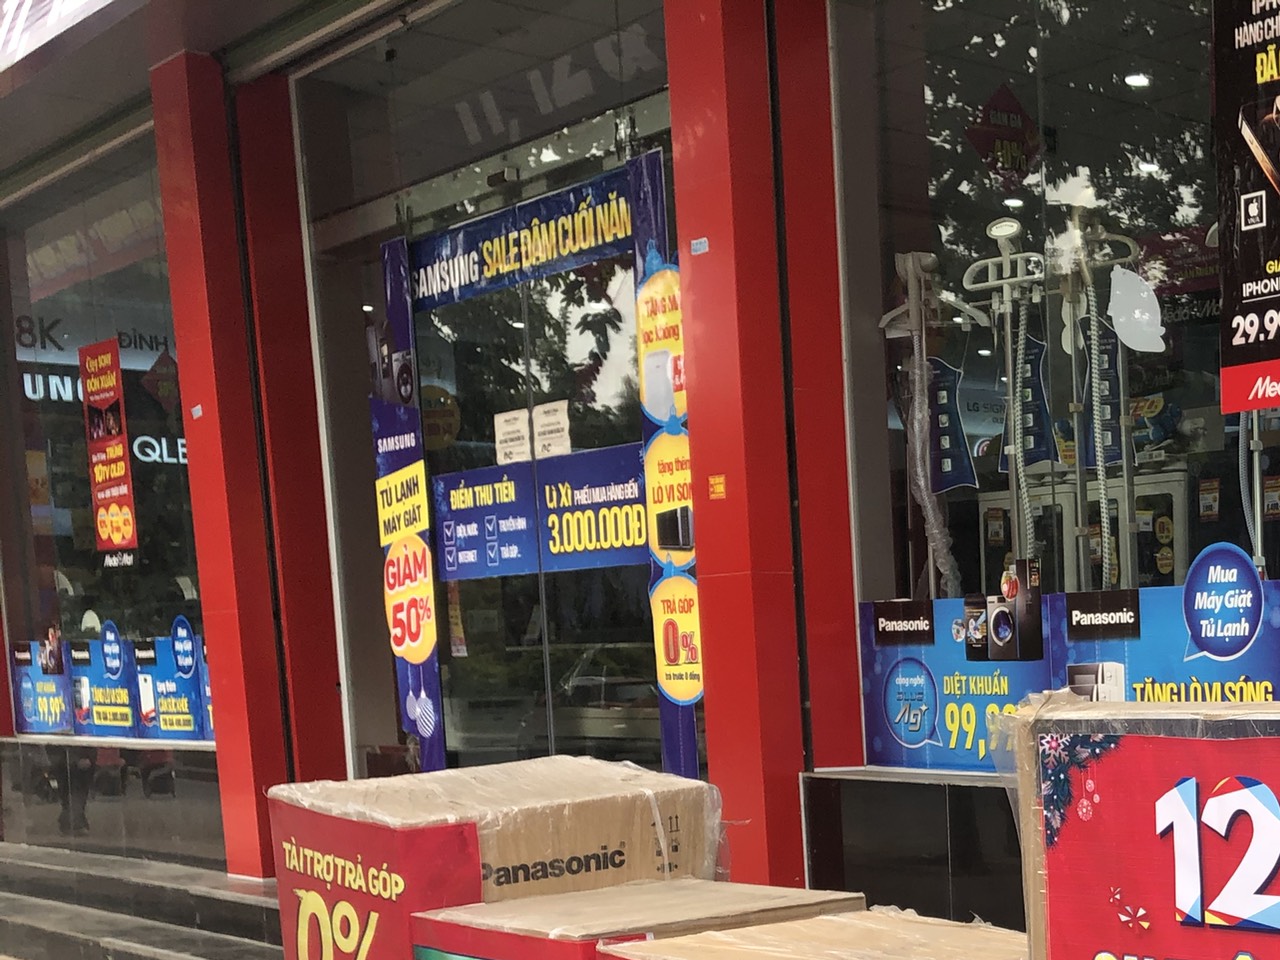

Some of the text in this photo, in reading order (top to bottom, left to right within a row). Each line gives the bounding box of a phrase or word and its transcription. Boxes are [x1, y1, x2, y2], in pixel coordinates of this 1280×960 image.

[1235, 21, 1263, 49] HÀNG
[1256, 44, 1277, 84] ĐÃ
[412, 250, 479, 300] SAMSUNG
[482, 230, 520, 279] SALE
[557, 197, 596, 256] CUỐI
[15, 315, 64, 351] 8K
[23, 373, 83, 402] UN
[377, 432, 416, 453] SAMSUNG
[379, 474, 420, 510] TỦ LẠNH
[450, 475, 516, 511] ĐIỂM THU TIỀN
[606, 484, 623, 501] HÀNG
[622, 478, 639, 499] ĐẾN
[652, 481, 675, 505] LÒ VI
[383, 504, 422, 537] MÁY GIẶT
[547, 504, 647, 554] 3.000.000Đ
[386, 544, 428, 591] GIẢM
[391, 595, 432, 647] 50%
[661, 594, 695, 615] TRẢ GÓP
[1072, 608, 1135, 626] Panasonic
[878, 617, 930, 632] Panasonic
[943, 669, 1009, 699] DIỆT KHUẨN
[282, 837, 405, 901] TÀI TRỢ TRẢ GÓP
